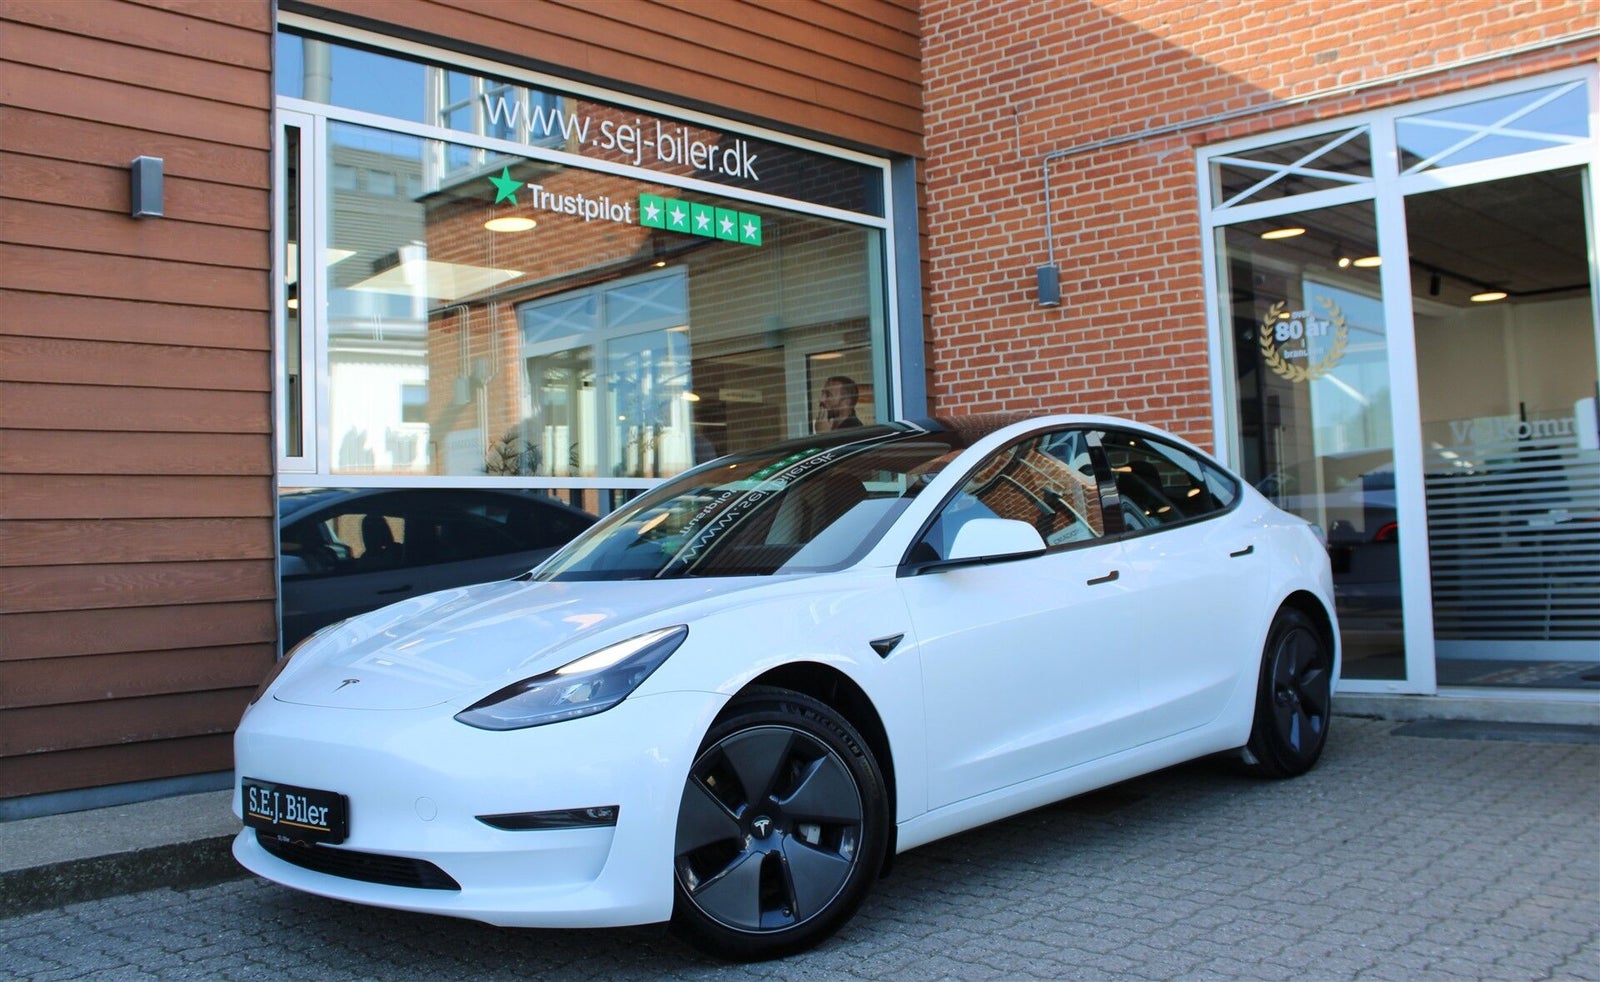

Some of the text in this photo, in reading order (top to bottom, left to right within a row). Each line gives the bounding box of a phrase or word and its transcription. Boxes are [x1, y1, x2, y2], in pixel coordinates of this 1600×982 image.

[483, 92, 760, 182] www.sej-biler.dk
[527, 182, 632, 224] Trustpilot
[1275, 317, 1330, 341] 80 år
[249, 786, 328, 826] S.E.J. Biler
